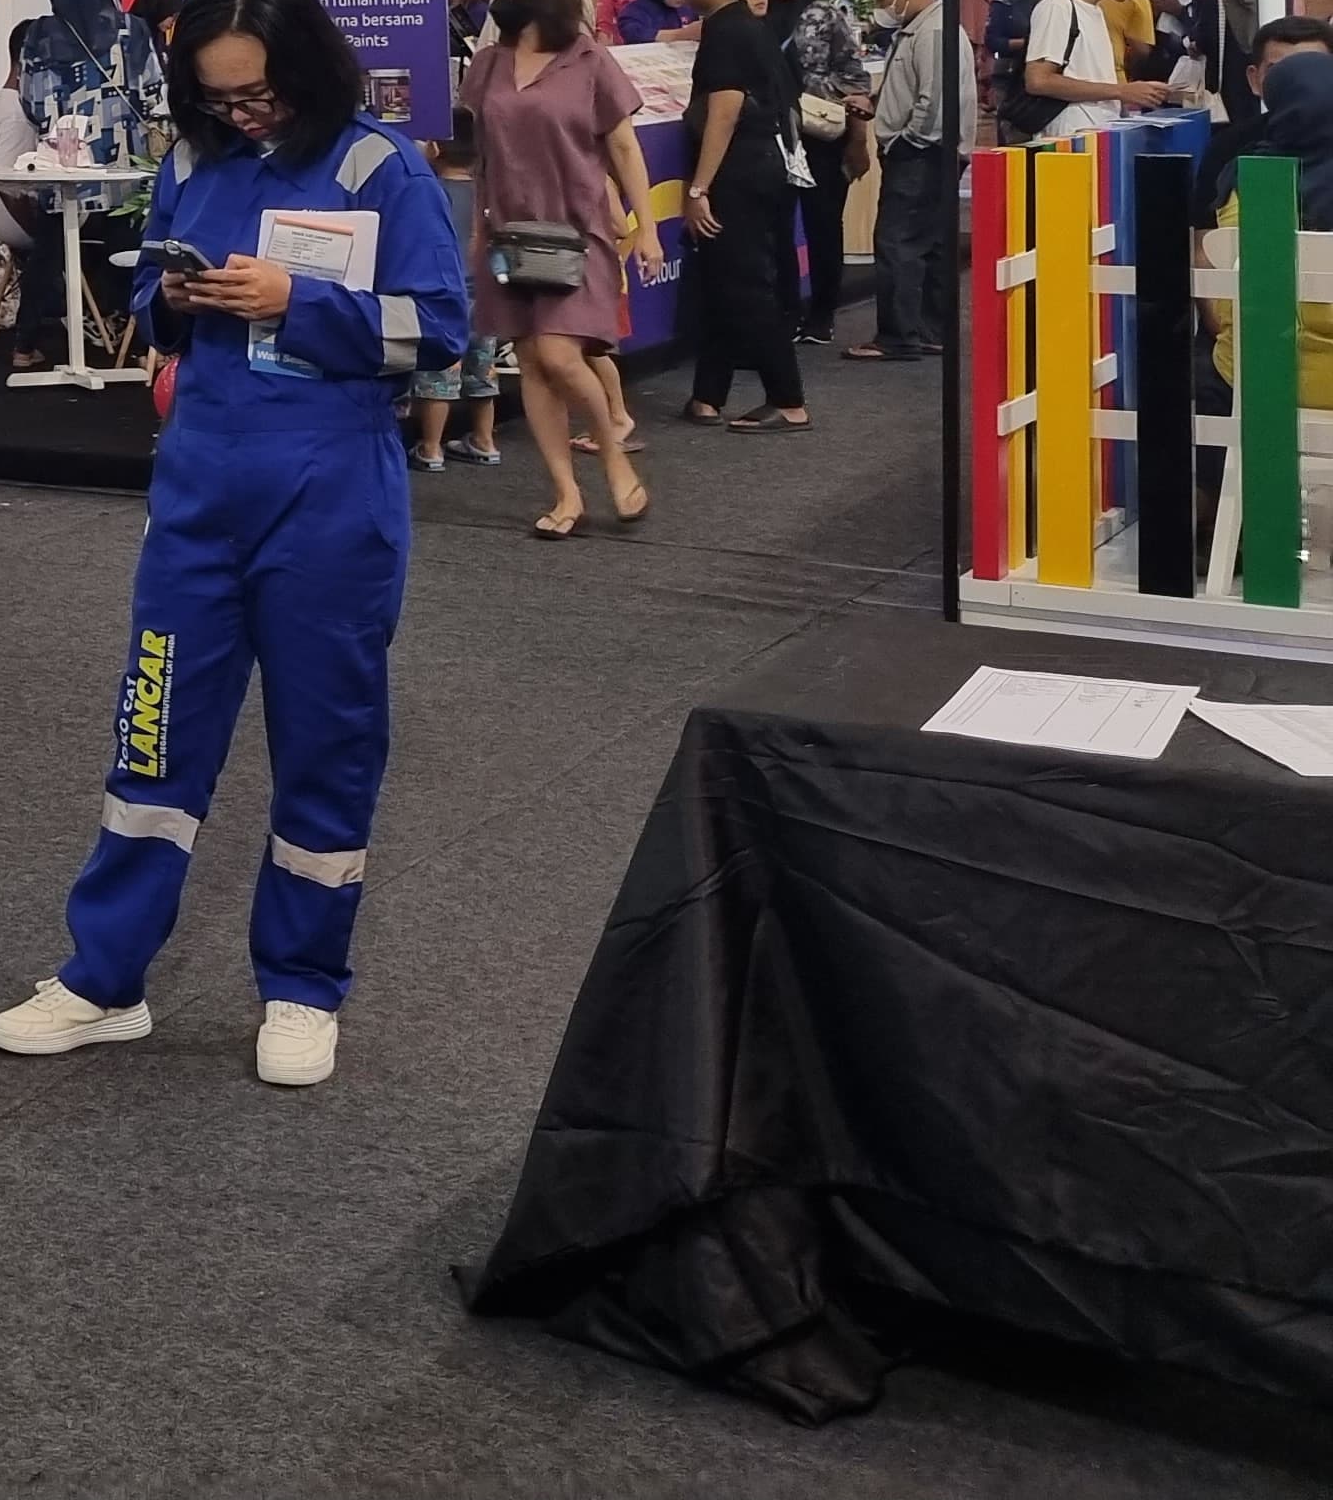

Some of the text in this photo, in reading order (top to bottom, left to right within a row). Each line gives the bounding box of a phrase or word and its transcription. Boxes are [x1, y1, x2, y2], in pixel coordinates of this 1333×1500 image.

[335, 13, 424, 27] rna bersama
[166, 659, 174, 674] CAT
[129, 629, 167, 777] LANCAR
[161, 675, 173, 725] KEBUTUHAN
[117, 676, 136, 771] TOKO CAT
[160, 726, 168, 755] SEGALA
